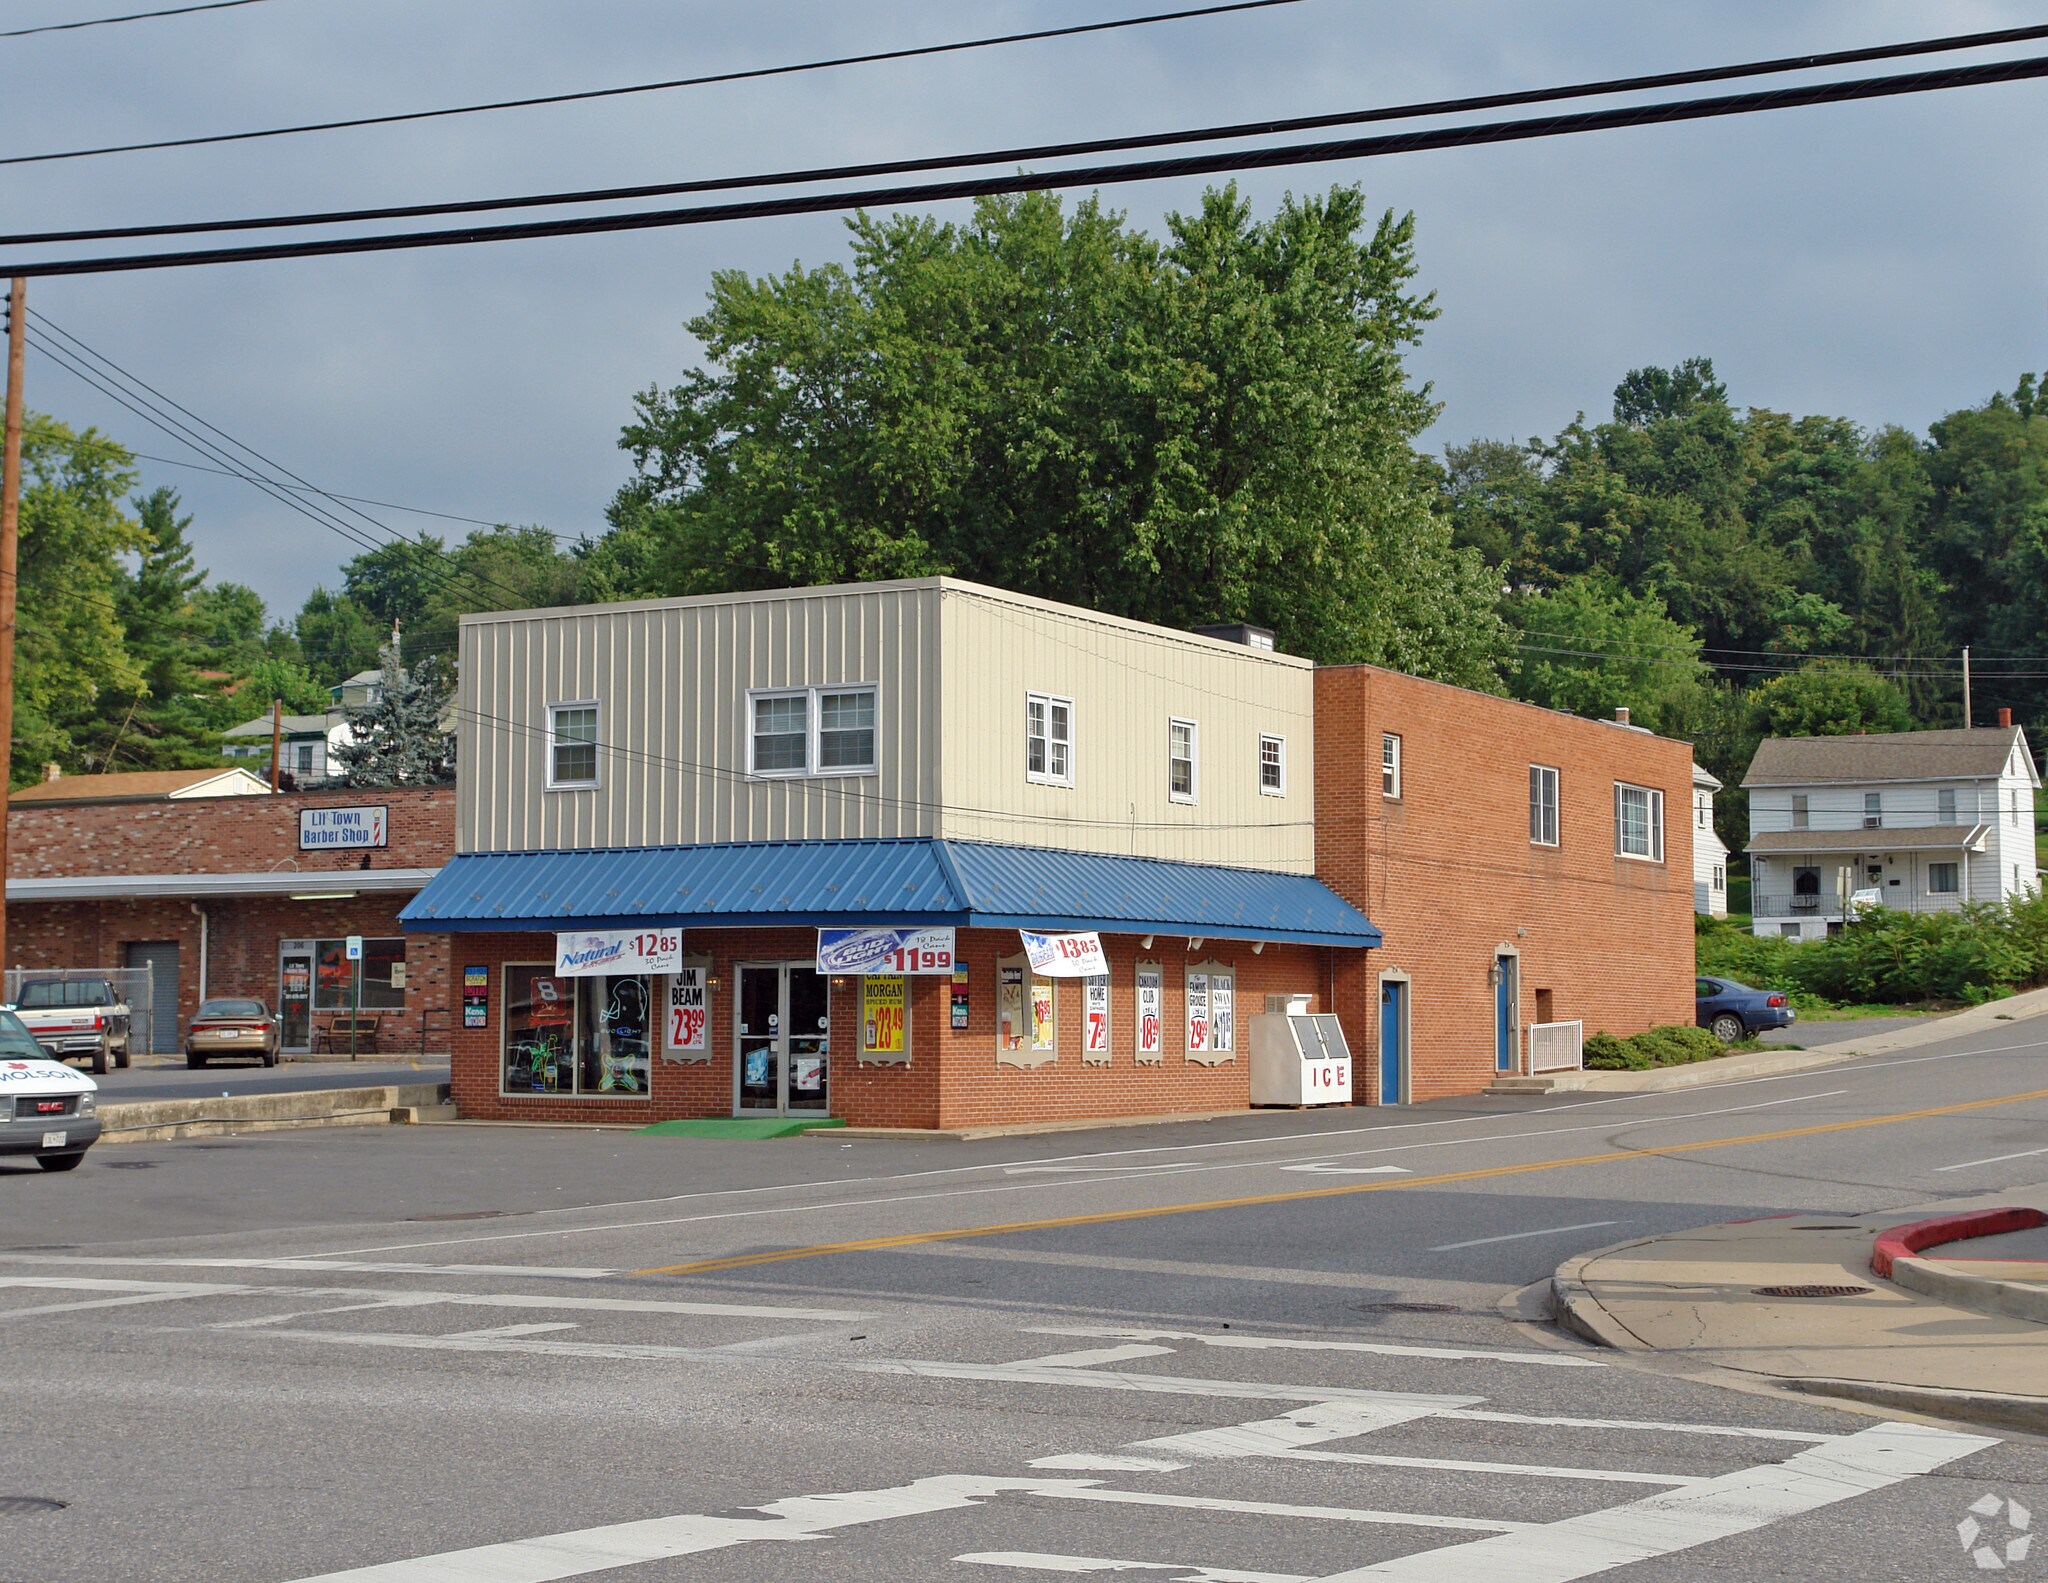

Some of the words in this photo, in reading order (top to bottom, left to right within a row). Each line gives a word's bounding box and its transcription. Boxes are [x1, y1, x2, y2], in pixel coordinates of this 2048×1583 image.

[331, 811, 361, 827] Town
[304, 830, 340, 844] Barber
[342, 827, 369, 843] Shop
[559, 940, 624, 969] Natural
[829, 941, 894, 966] LIGHT
[842, 938, 885, 957] BUD
[676, 969, 697, 987] JIM
[1213, 977, 1231, 990] BLACK
[671, 987, 703, 1006] BEAM
[866, 984, 903, 998] MORGAN
[1089, 987, 1105, 1001] HOME
[1142, 990, 1155, 1004] CLUB
[1214, 992, 1230, 1005] SWAN
